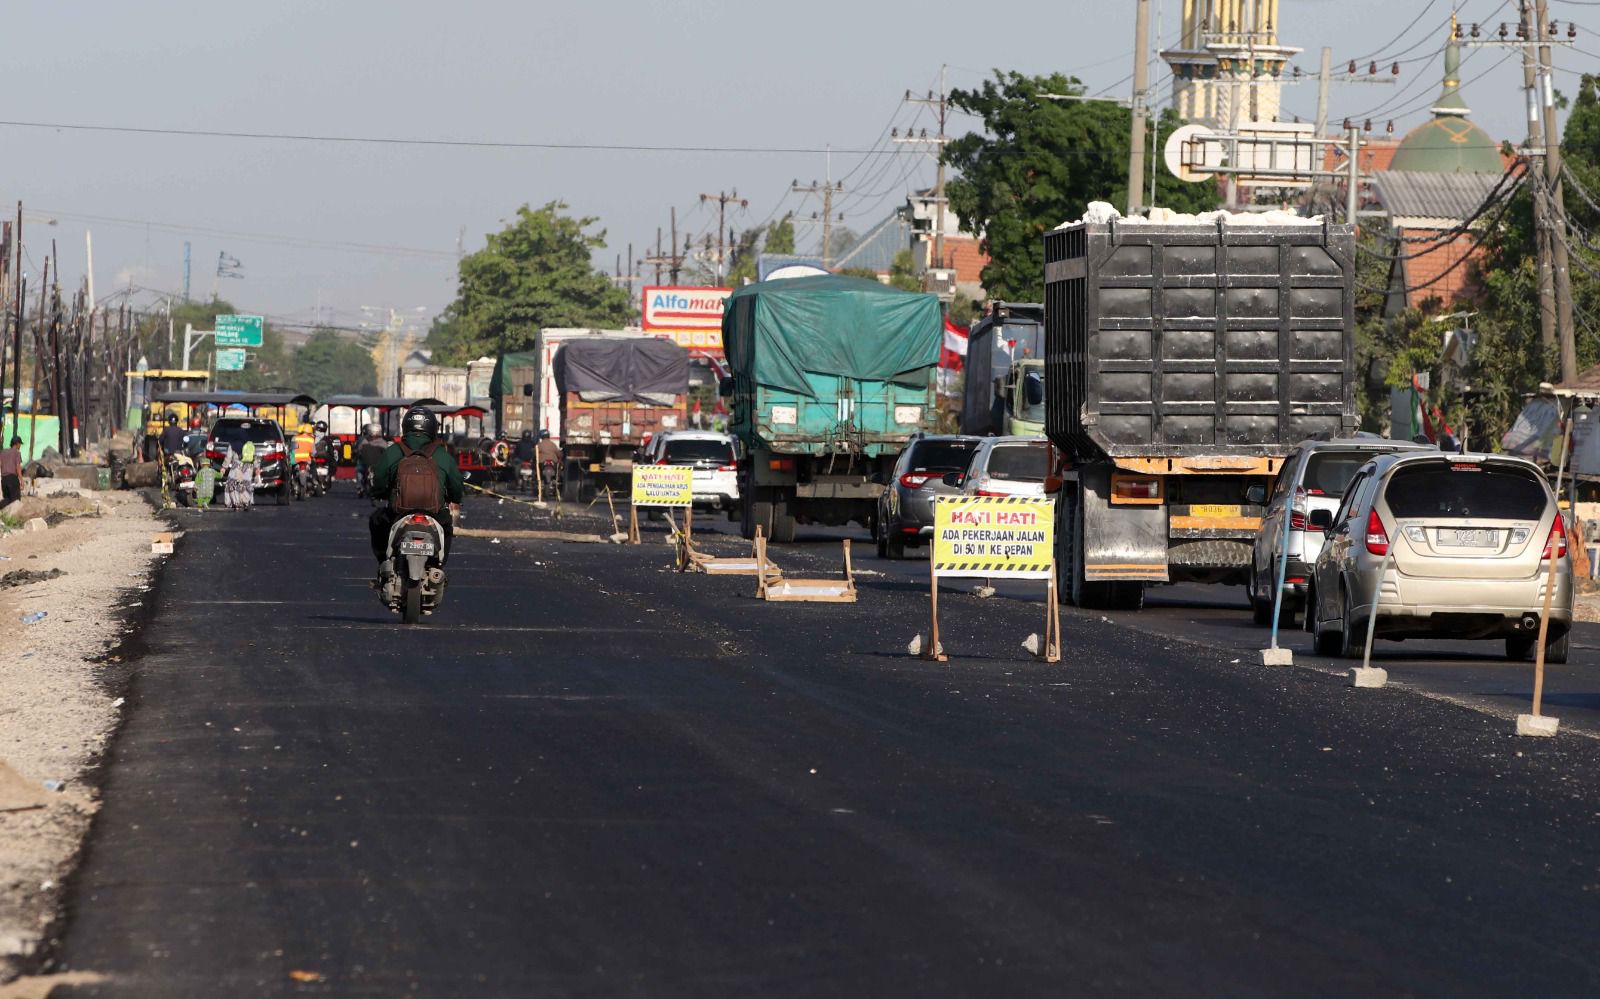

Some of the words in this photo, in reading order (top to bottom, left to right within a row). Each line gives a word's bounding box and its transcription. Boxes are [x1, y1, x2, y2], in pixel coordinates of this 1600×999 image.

[653, 294, 721, 310] Alfamar
[951, 511, 991, 524] HATI
[996, 511, 1036, 525] HATI
[942, 529, 960, 540] ADA
[962, 529, 1014, 541] PEKERJAAN
[1016, 531, 1045, 542] JALAN
[953, 543, 962, 554] DI
[977, 544, 985, 555] M
[990, 544, 1002, 555] KE
[1004, 545, 1033, 556] DEPAN
